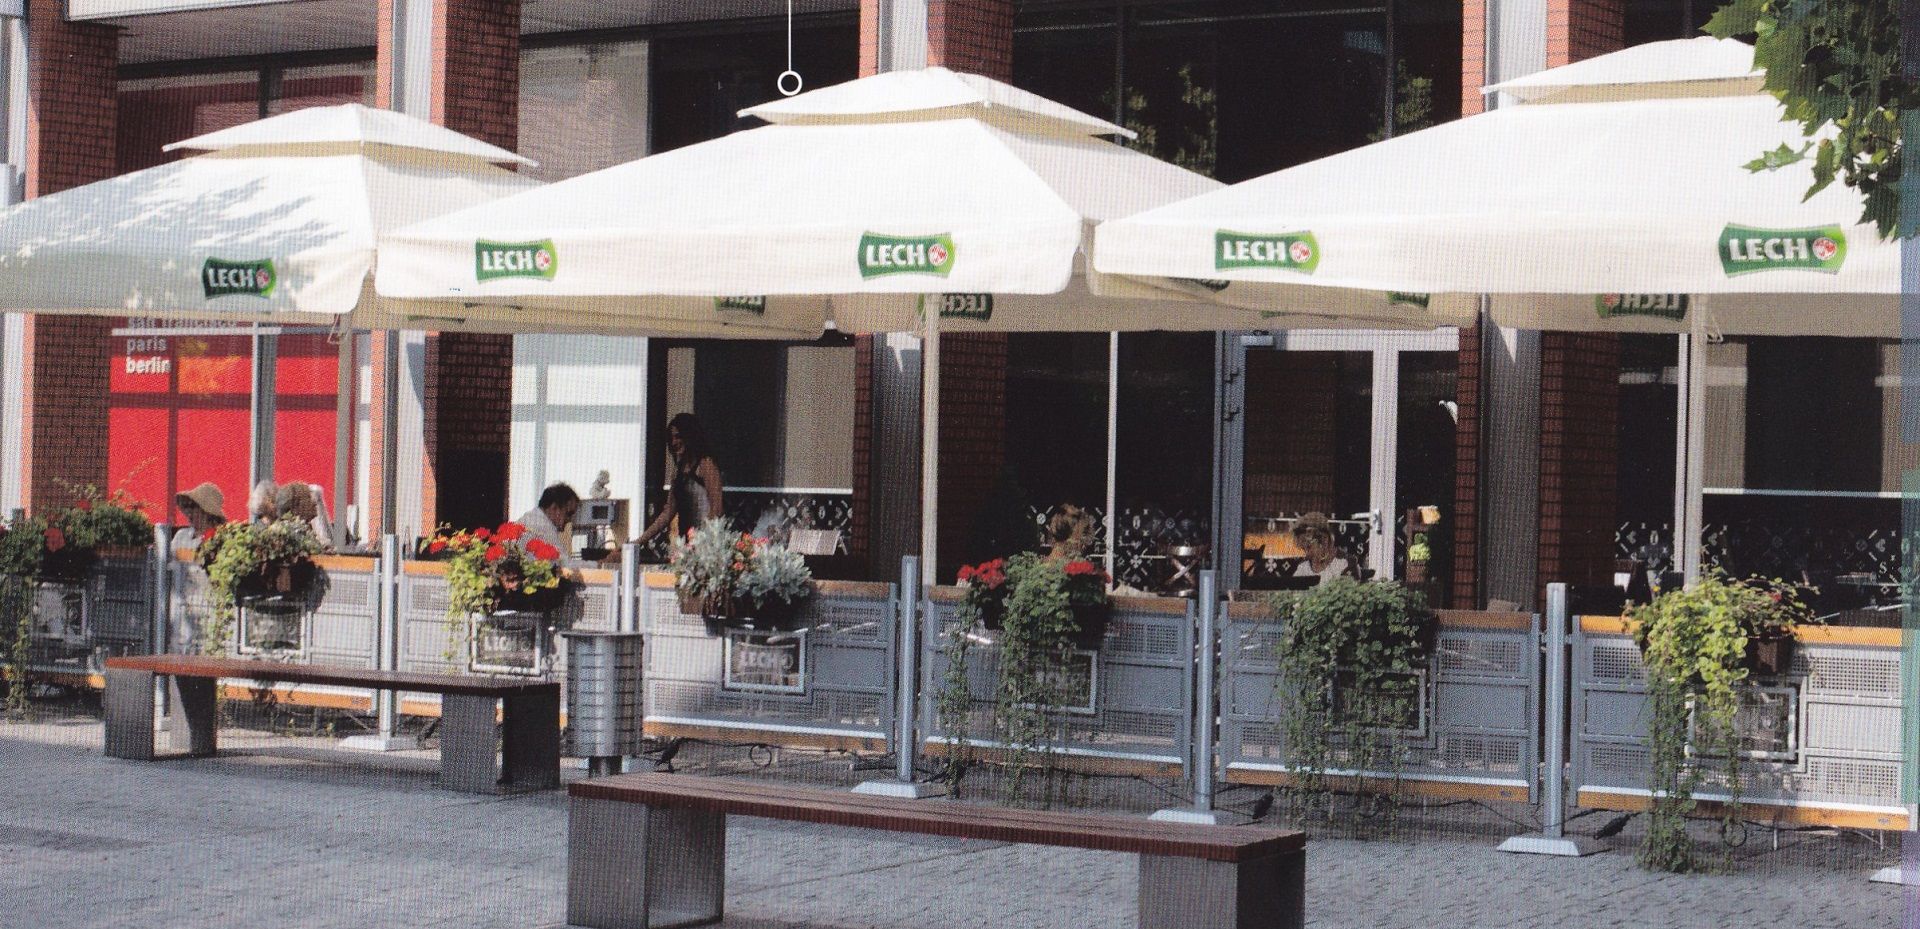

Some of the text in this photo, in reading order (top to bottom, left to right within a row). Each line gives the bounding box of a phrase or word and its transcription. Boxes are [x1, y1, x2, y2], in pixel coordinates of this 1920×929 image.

[866, 244, 926, 267] LECH
[1223, 240, 1286, 262] LECH
[1728, 237, 1808, 261] LECH
[481, 249, 534, 272] LECH
[208, 267, 254, 289] LECH
[127, 337, 167, 355] paris
[126, 356, 171, 374] berlin
